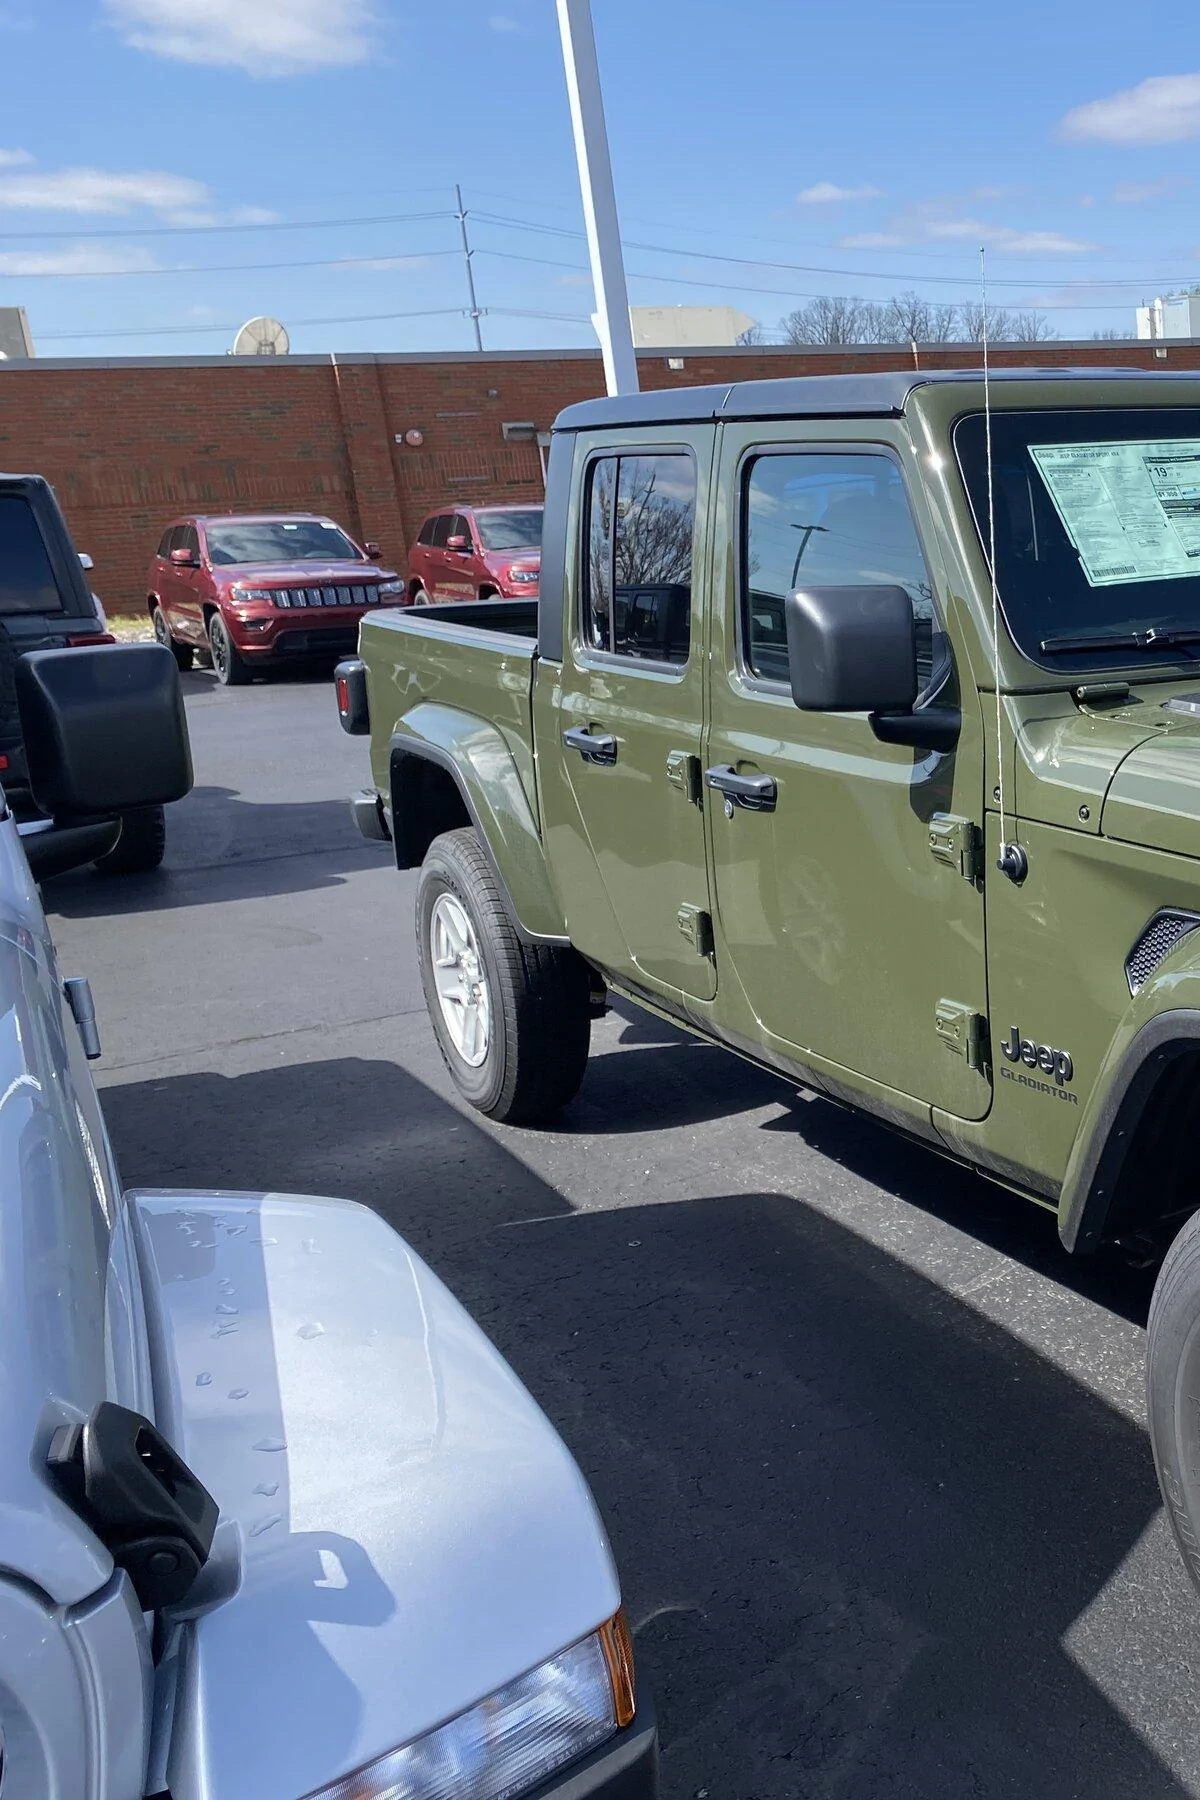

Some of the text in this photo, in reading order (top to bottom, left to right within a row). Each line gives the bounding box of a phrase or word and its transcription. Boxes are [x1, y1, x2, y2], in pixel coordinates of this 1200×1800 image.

[1154, 467, 1168, 477] 19
[1000, 1025, 1074, 1087] Jeep
[1000, 1066, 1079, 1106] GLADIATOR
